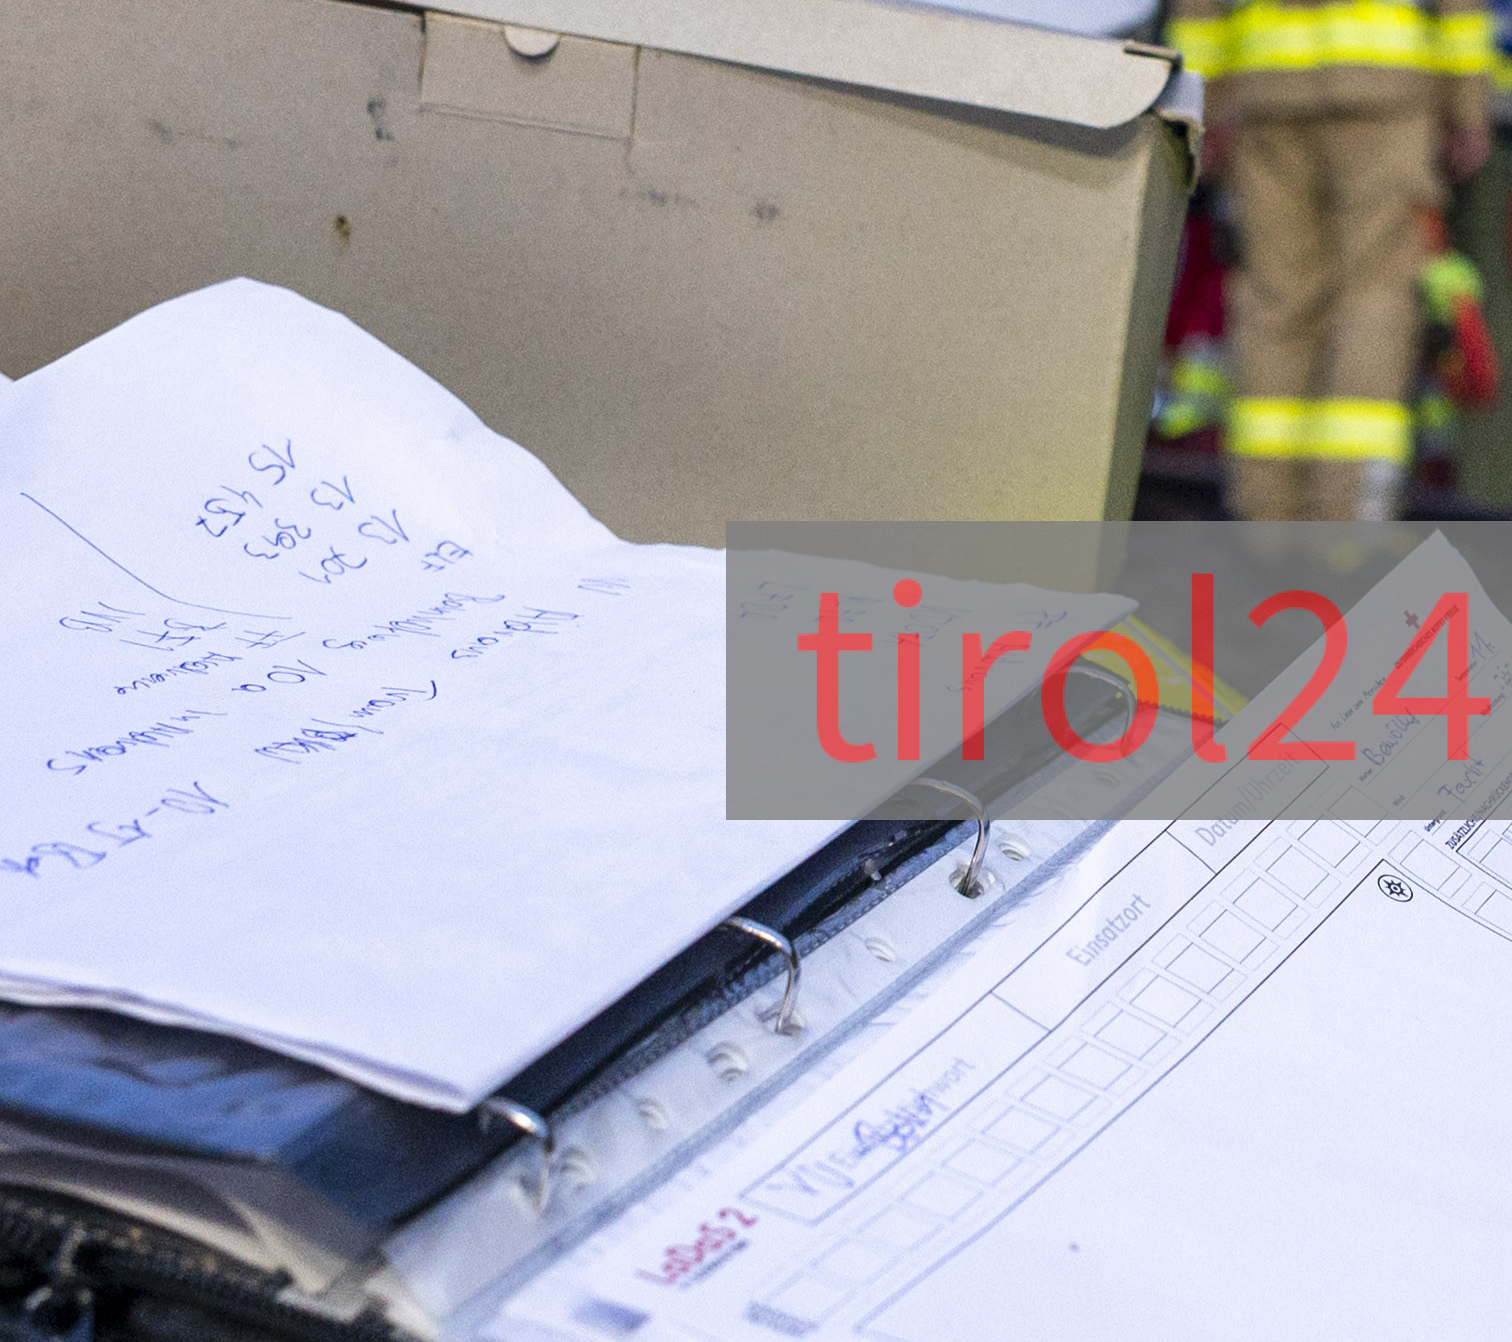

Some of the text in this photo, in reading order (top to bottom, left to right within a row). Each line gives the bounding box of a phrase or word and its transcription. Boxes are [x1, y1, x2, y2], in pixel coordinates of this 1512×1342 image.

[196, 437, 299, 537] 15 457
[310, 476, 357, 510] 13
[358, 509, 409, 545] 13
[1066, 891, 1152, 970] Einsatzort
